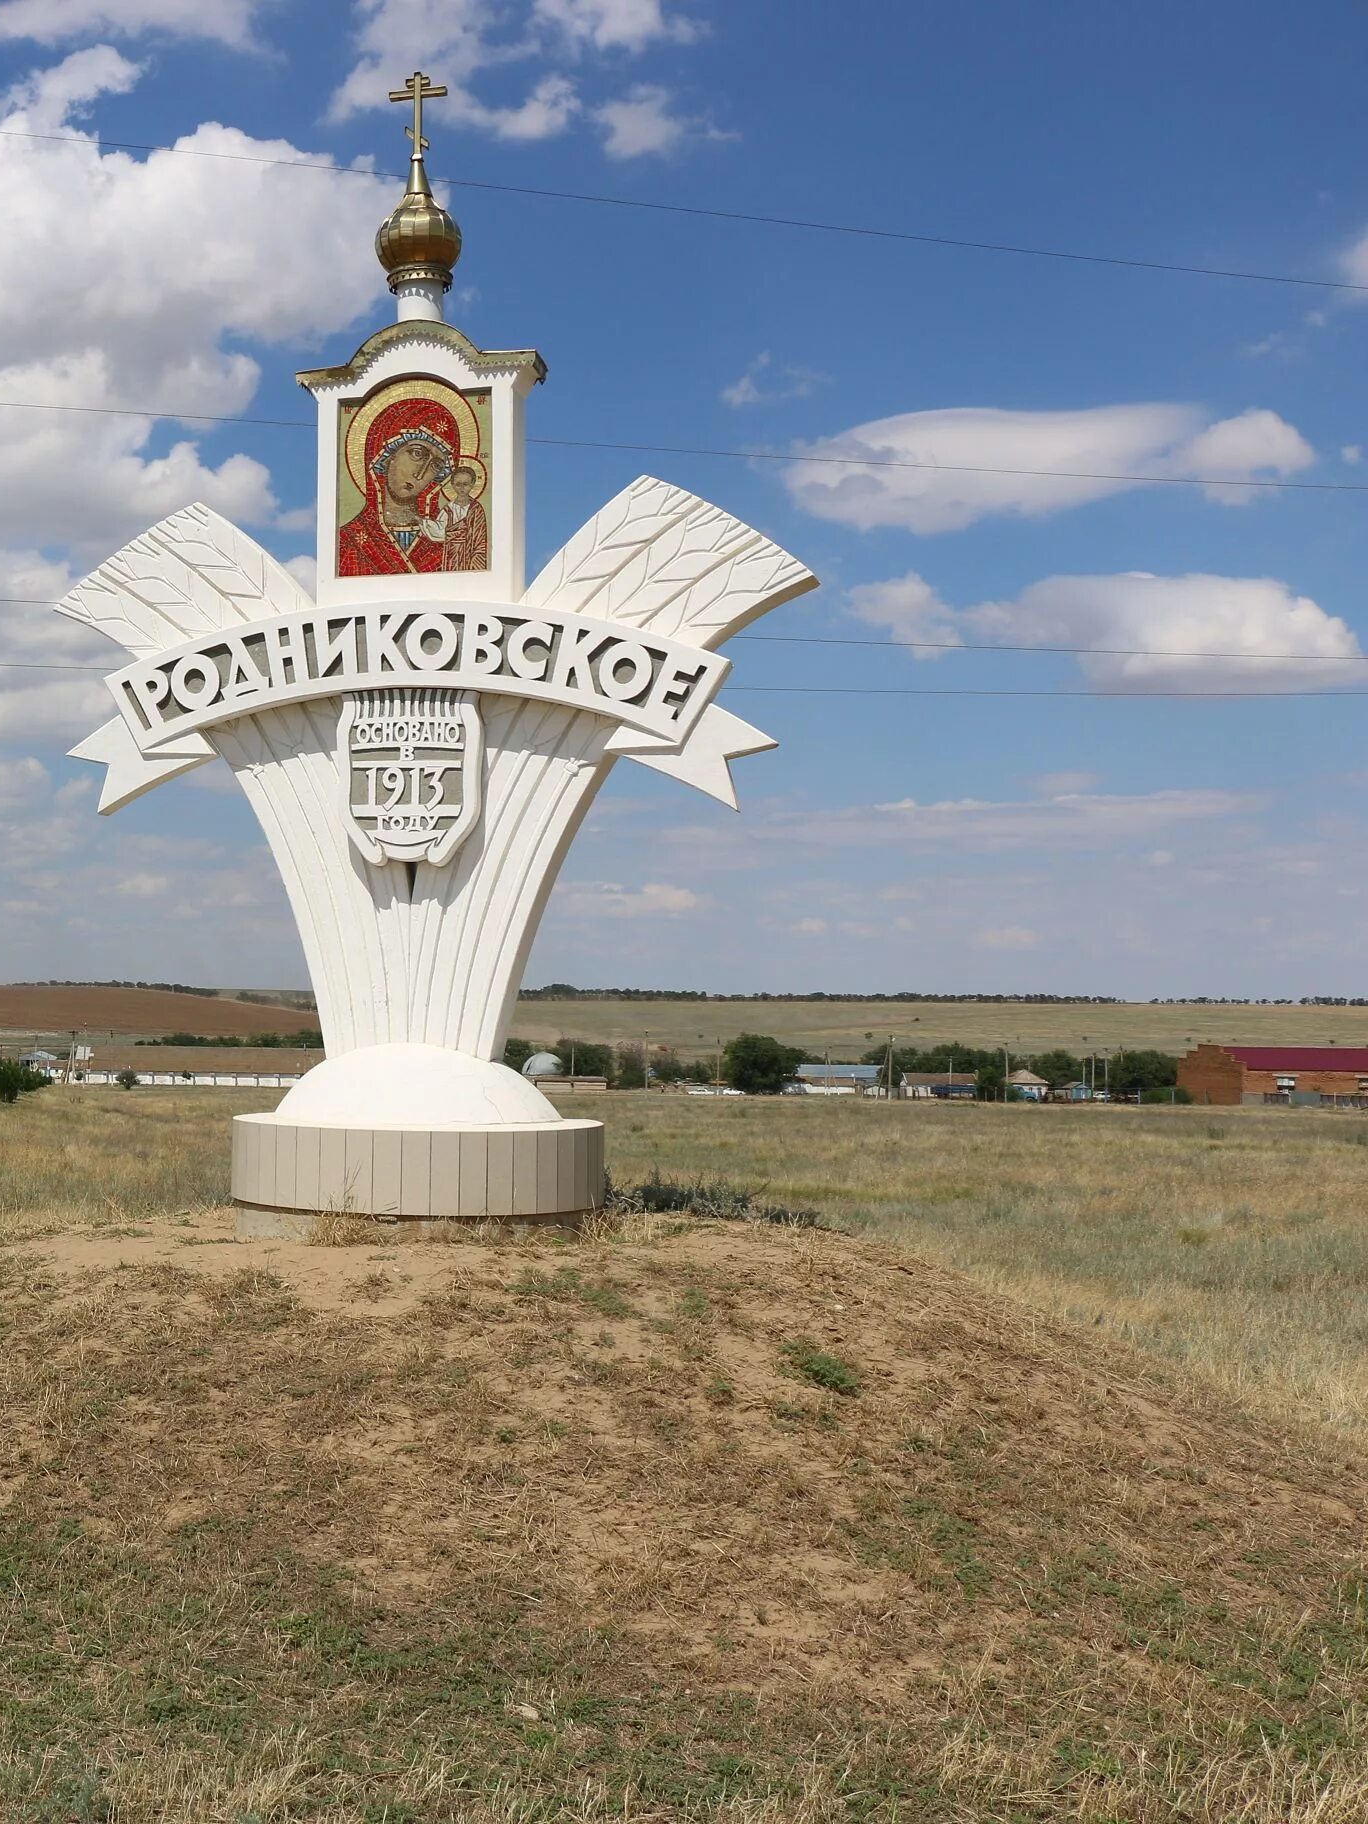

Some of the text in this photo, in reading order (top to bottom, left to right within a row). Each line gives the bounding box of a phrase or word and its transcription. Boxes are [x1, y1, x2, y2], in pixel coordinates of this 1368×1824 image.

[129, 611, 703, 729] РОДНИКОВСКОЕ
[356, 721, 460, 744] ОСНОВАНО
[399, 745, 415, 761] В
[365, 766, 444, 811] 1913
